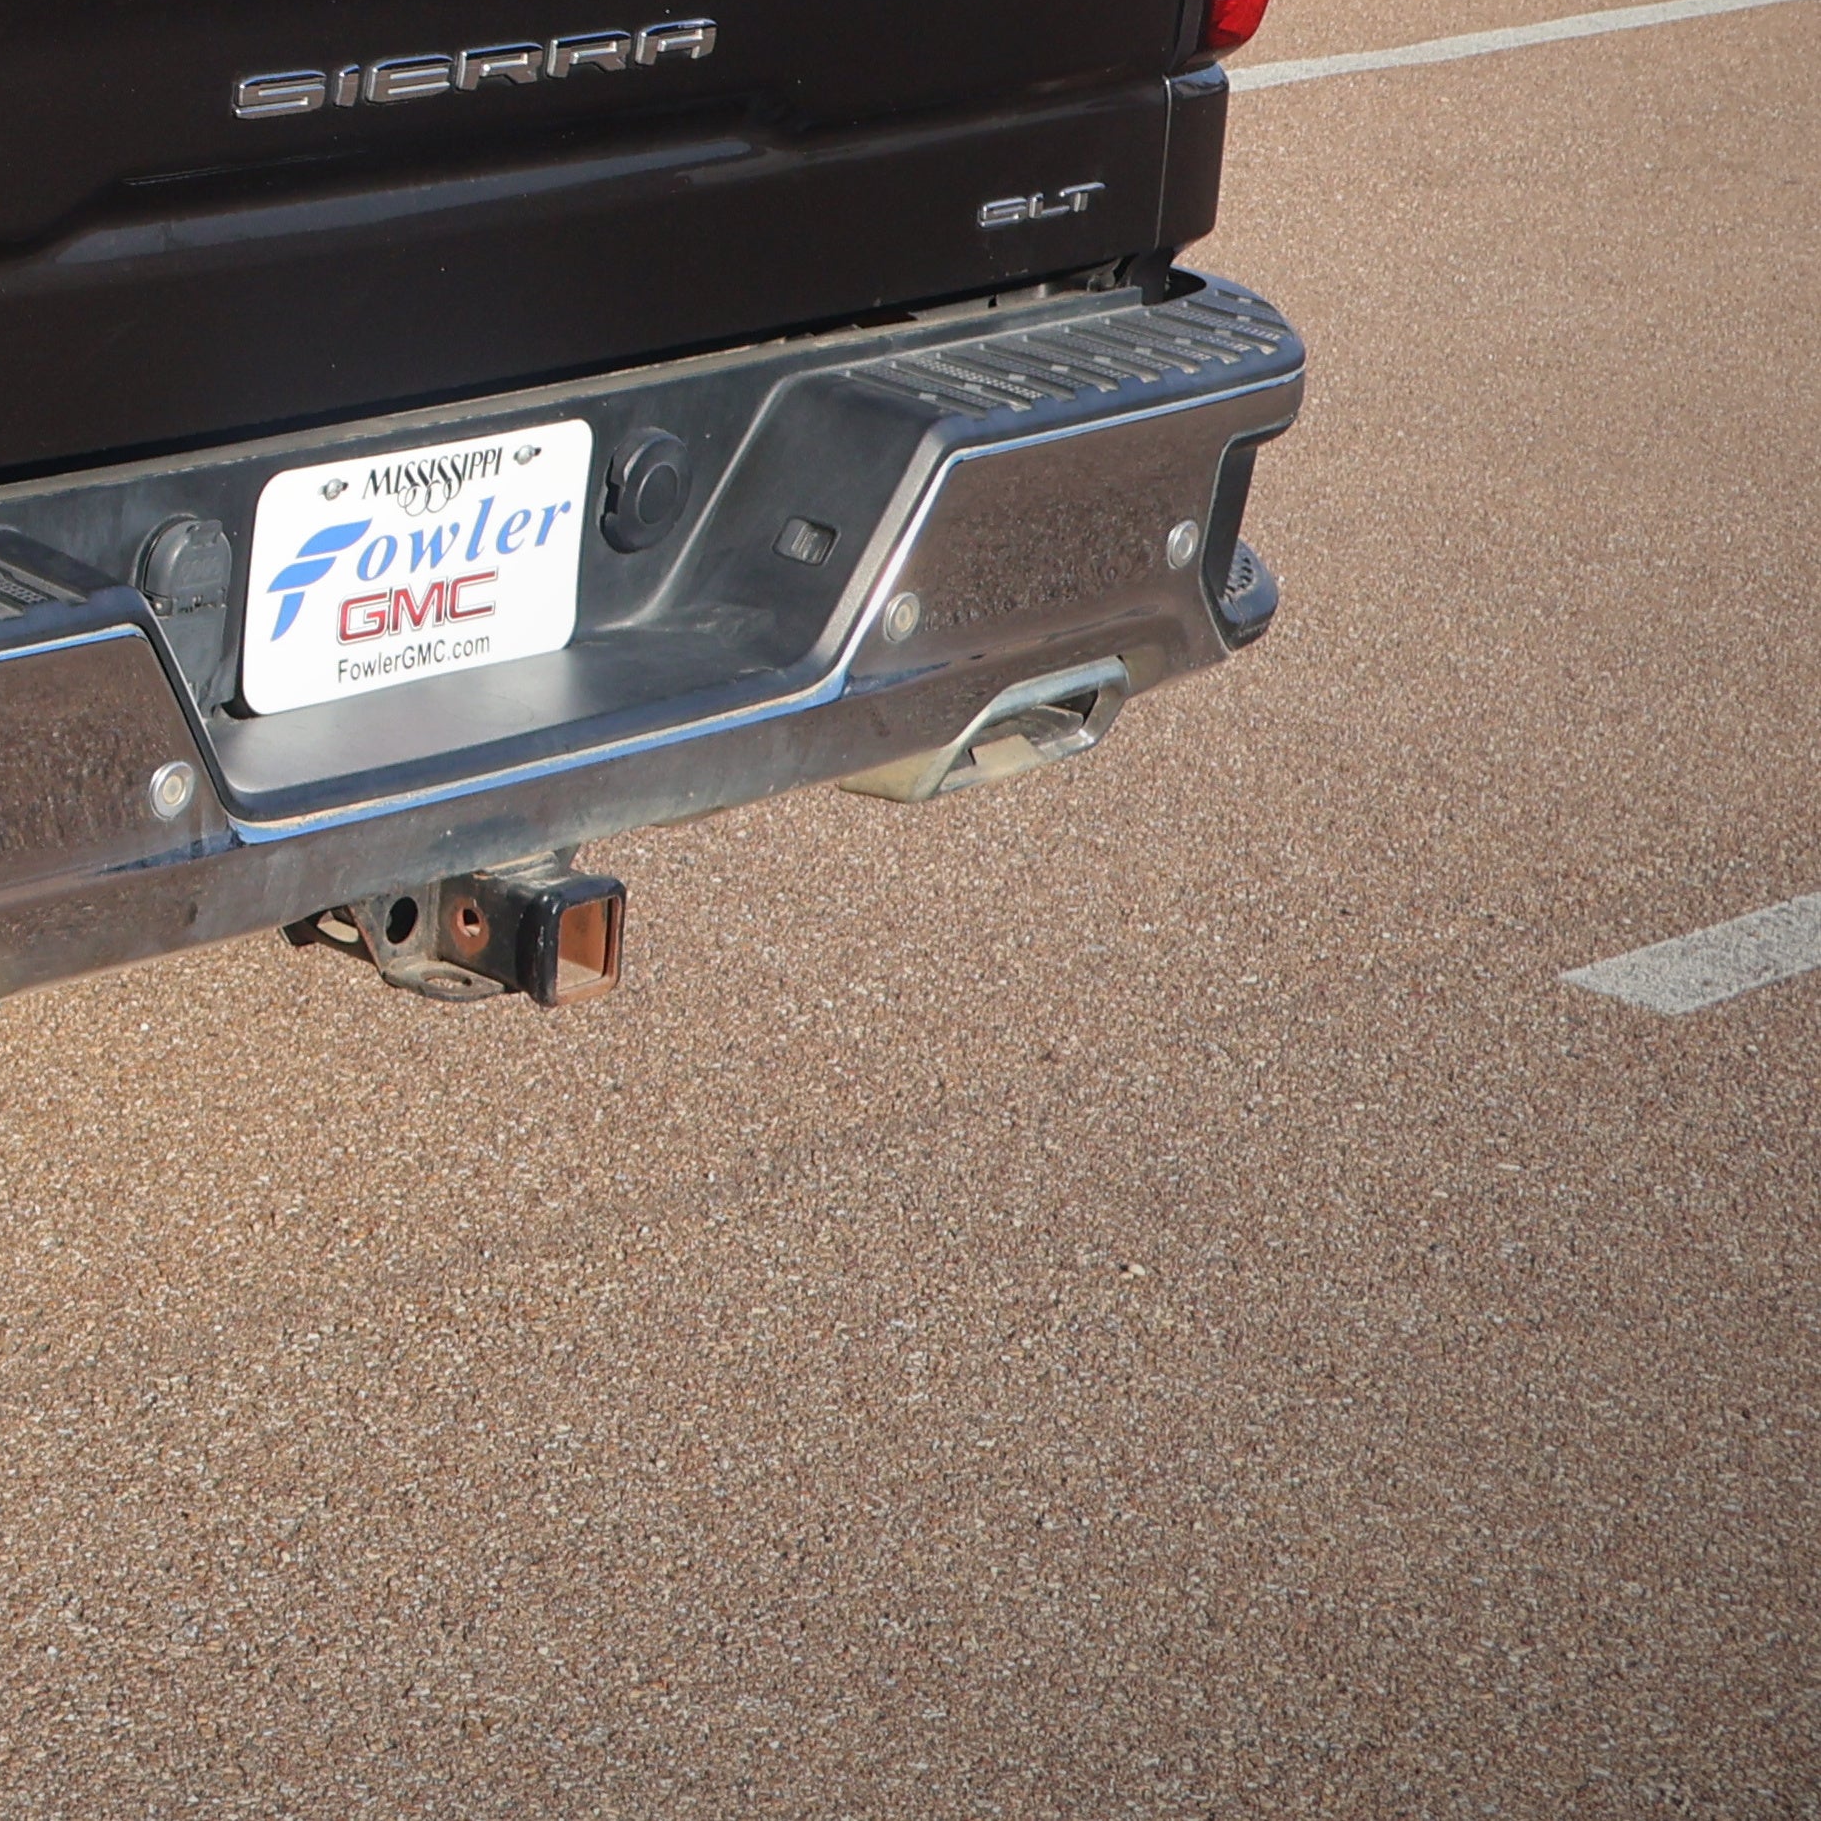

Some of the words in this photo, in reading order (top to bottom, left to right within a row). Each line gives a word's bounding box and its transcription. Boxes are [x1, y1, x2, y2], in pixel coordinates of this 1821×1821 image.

[232, 17, 718, 120] SIERRA
[977, 181, 1106, 229] SLT
[362, 447, 503, 516] MISSISSIPPI
[266, 495, 572, 641] Fowler
[337, 567, 498, 645] GMC
[338, 633, 491, 683] FowlerGMC.com
